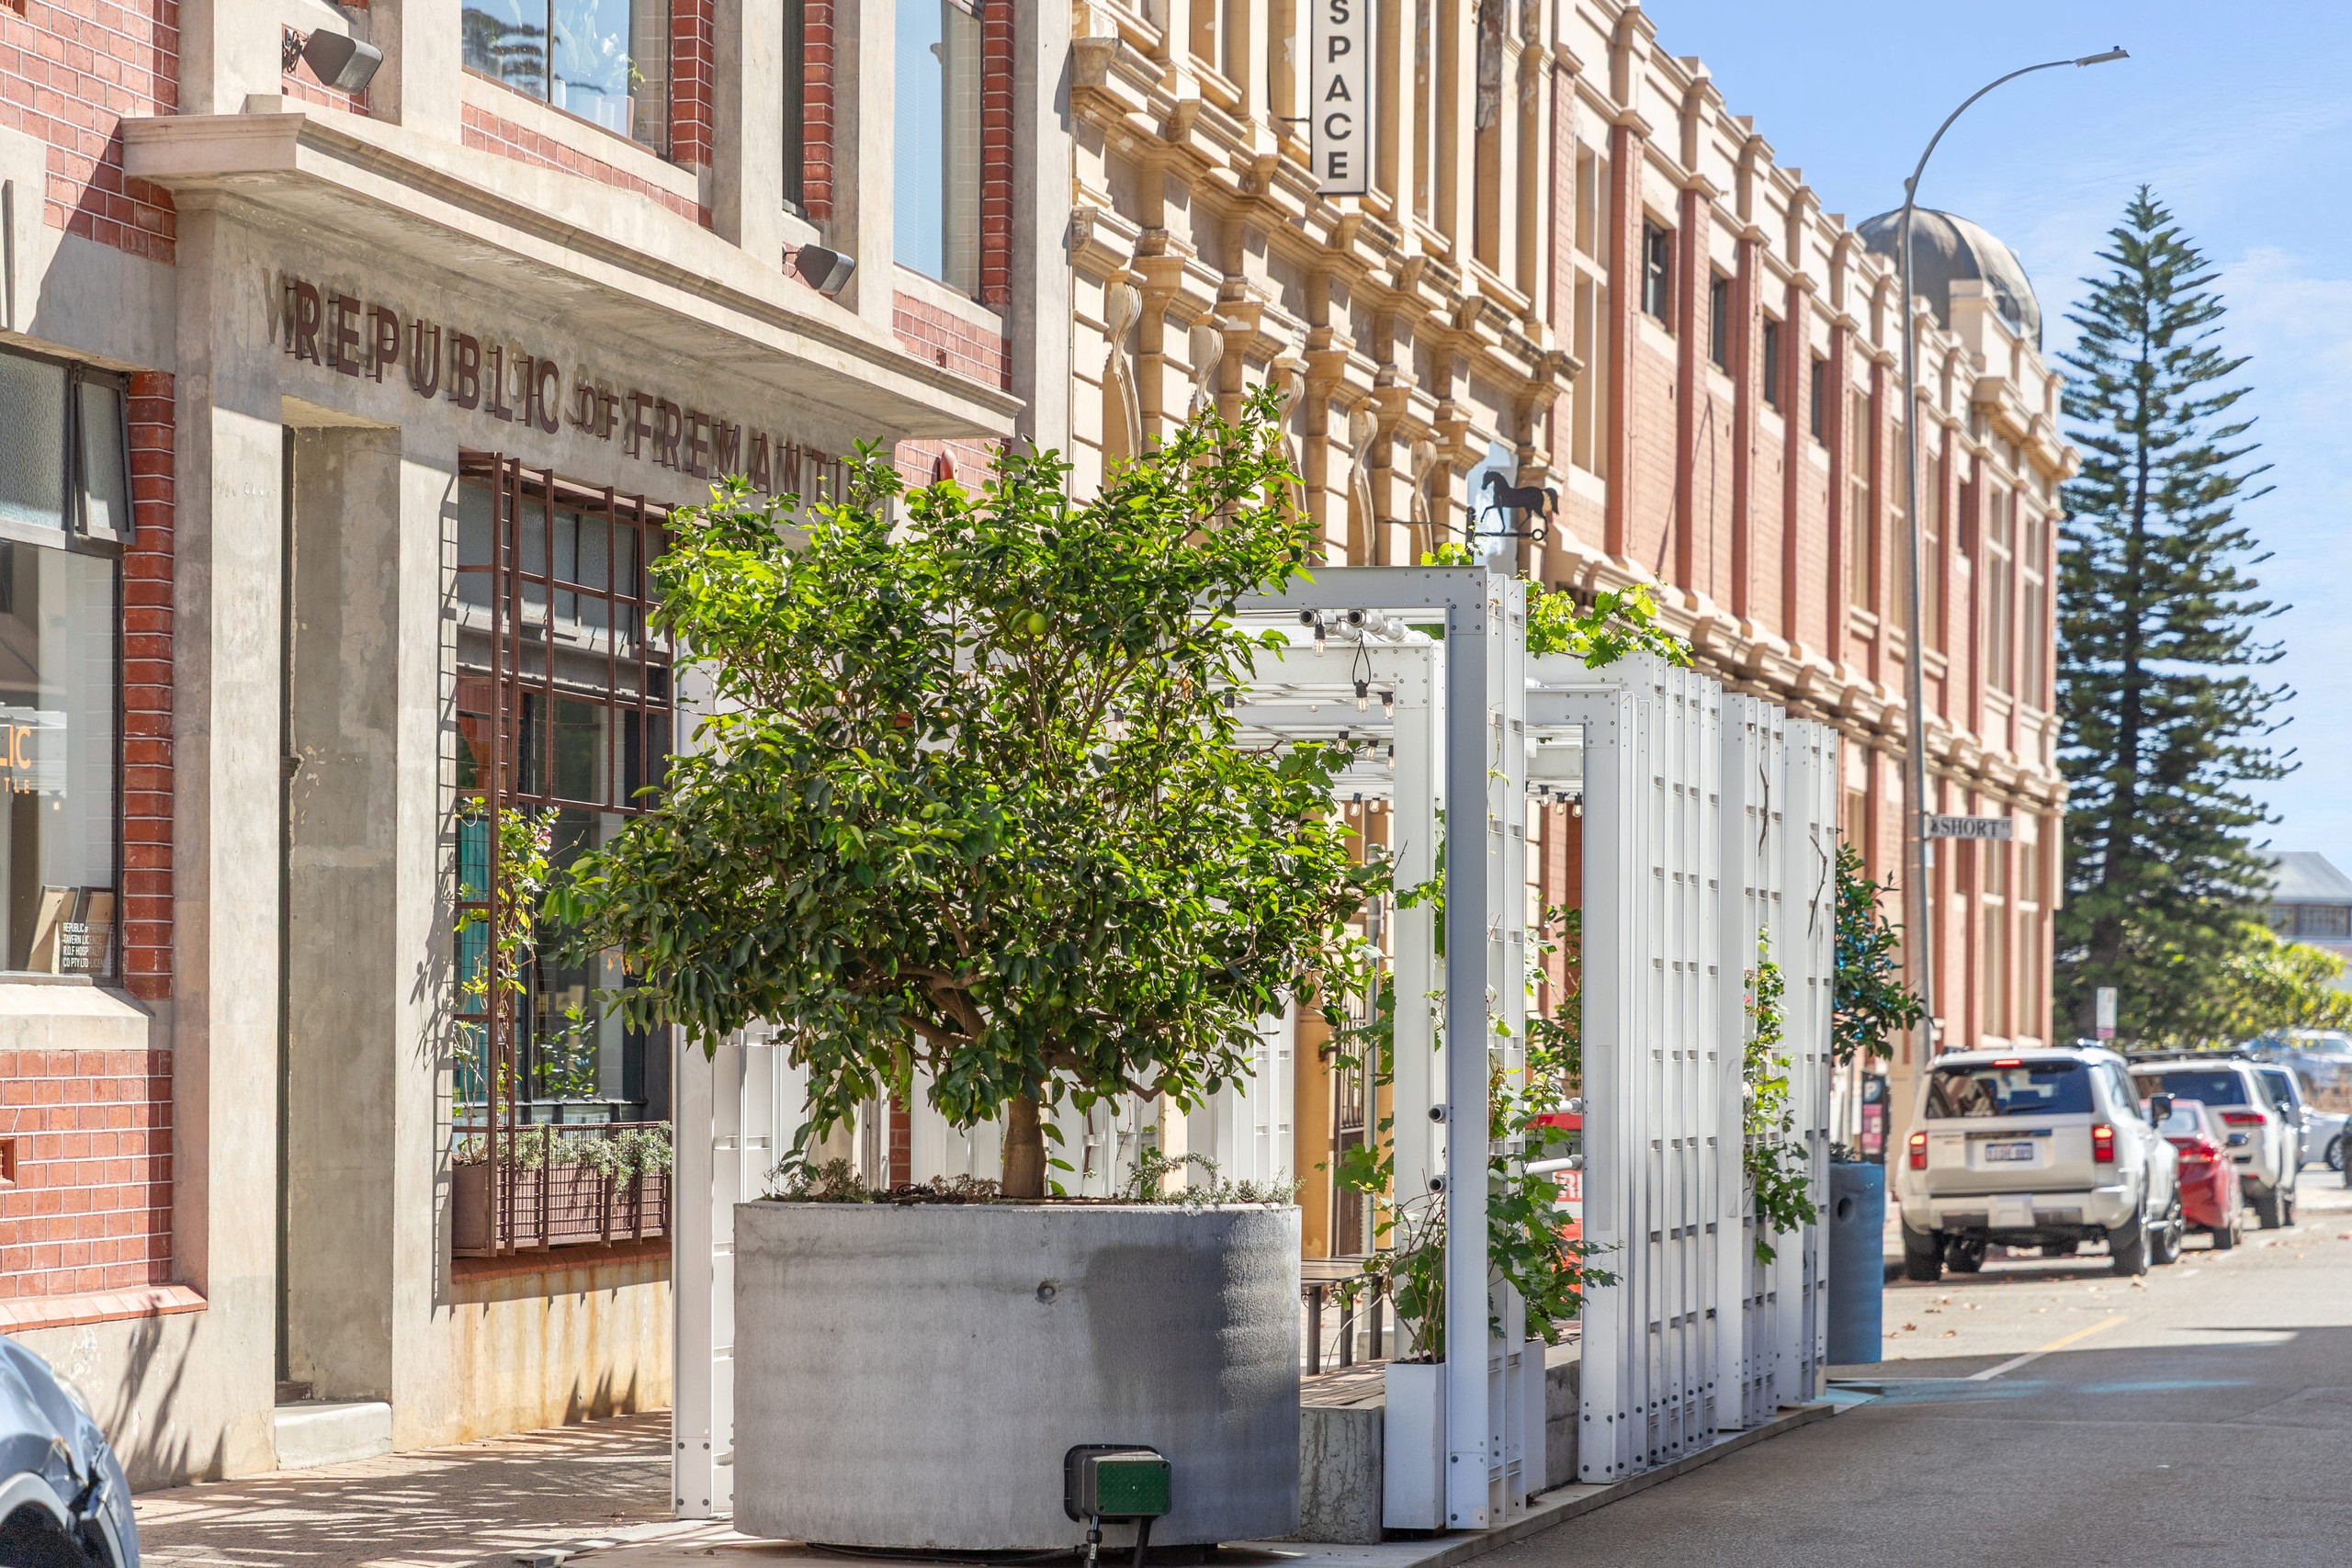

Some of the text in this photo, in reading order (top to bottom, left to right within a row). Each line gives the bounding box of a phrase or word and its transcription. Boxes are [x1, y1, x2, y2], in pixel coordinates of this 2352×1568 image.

[1324, 0, 1352, 179] SPACE
[294, 279, 560, 435] REPUBLIC
[1939, 818, 1998, 837] SHORT
[63, 922, 85, 932] REPUBLIC
[63, 933, 82, 944] TAVERN
